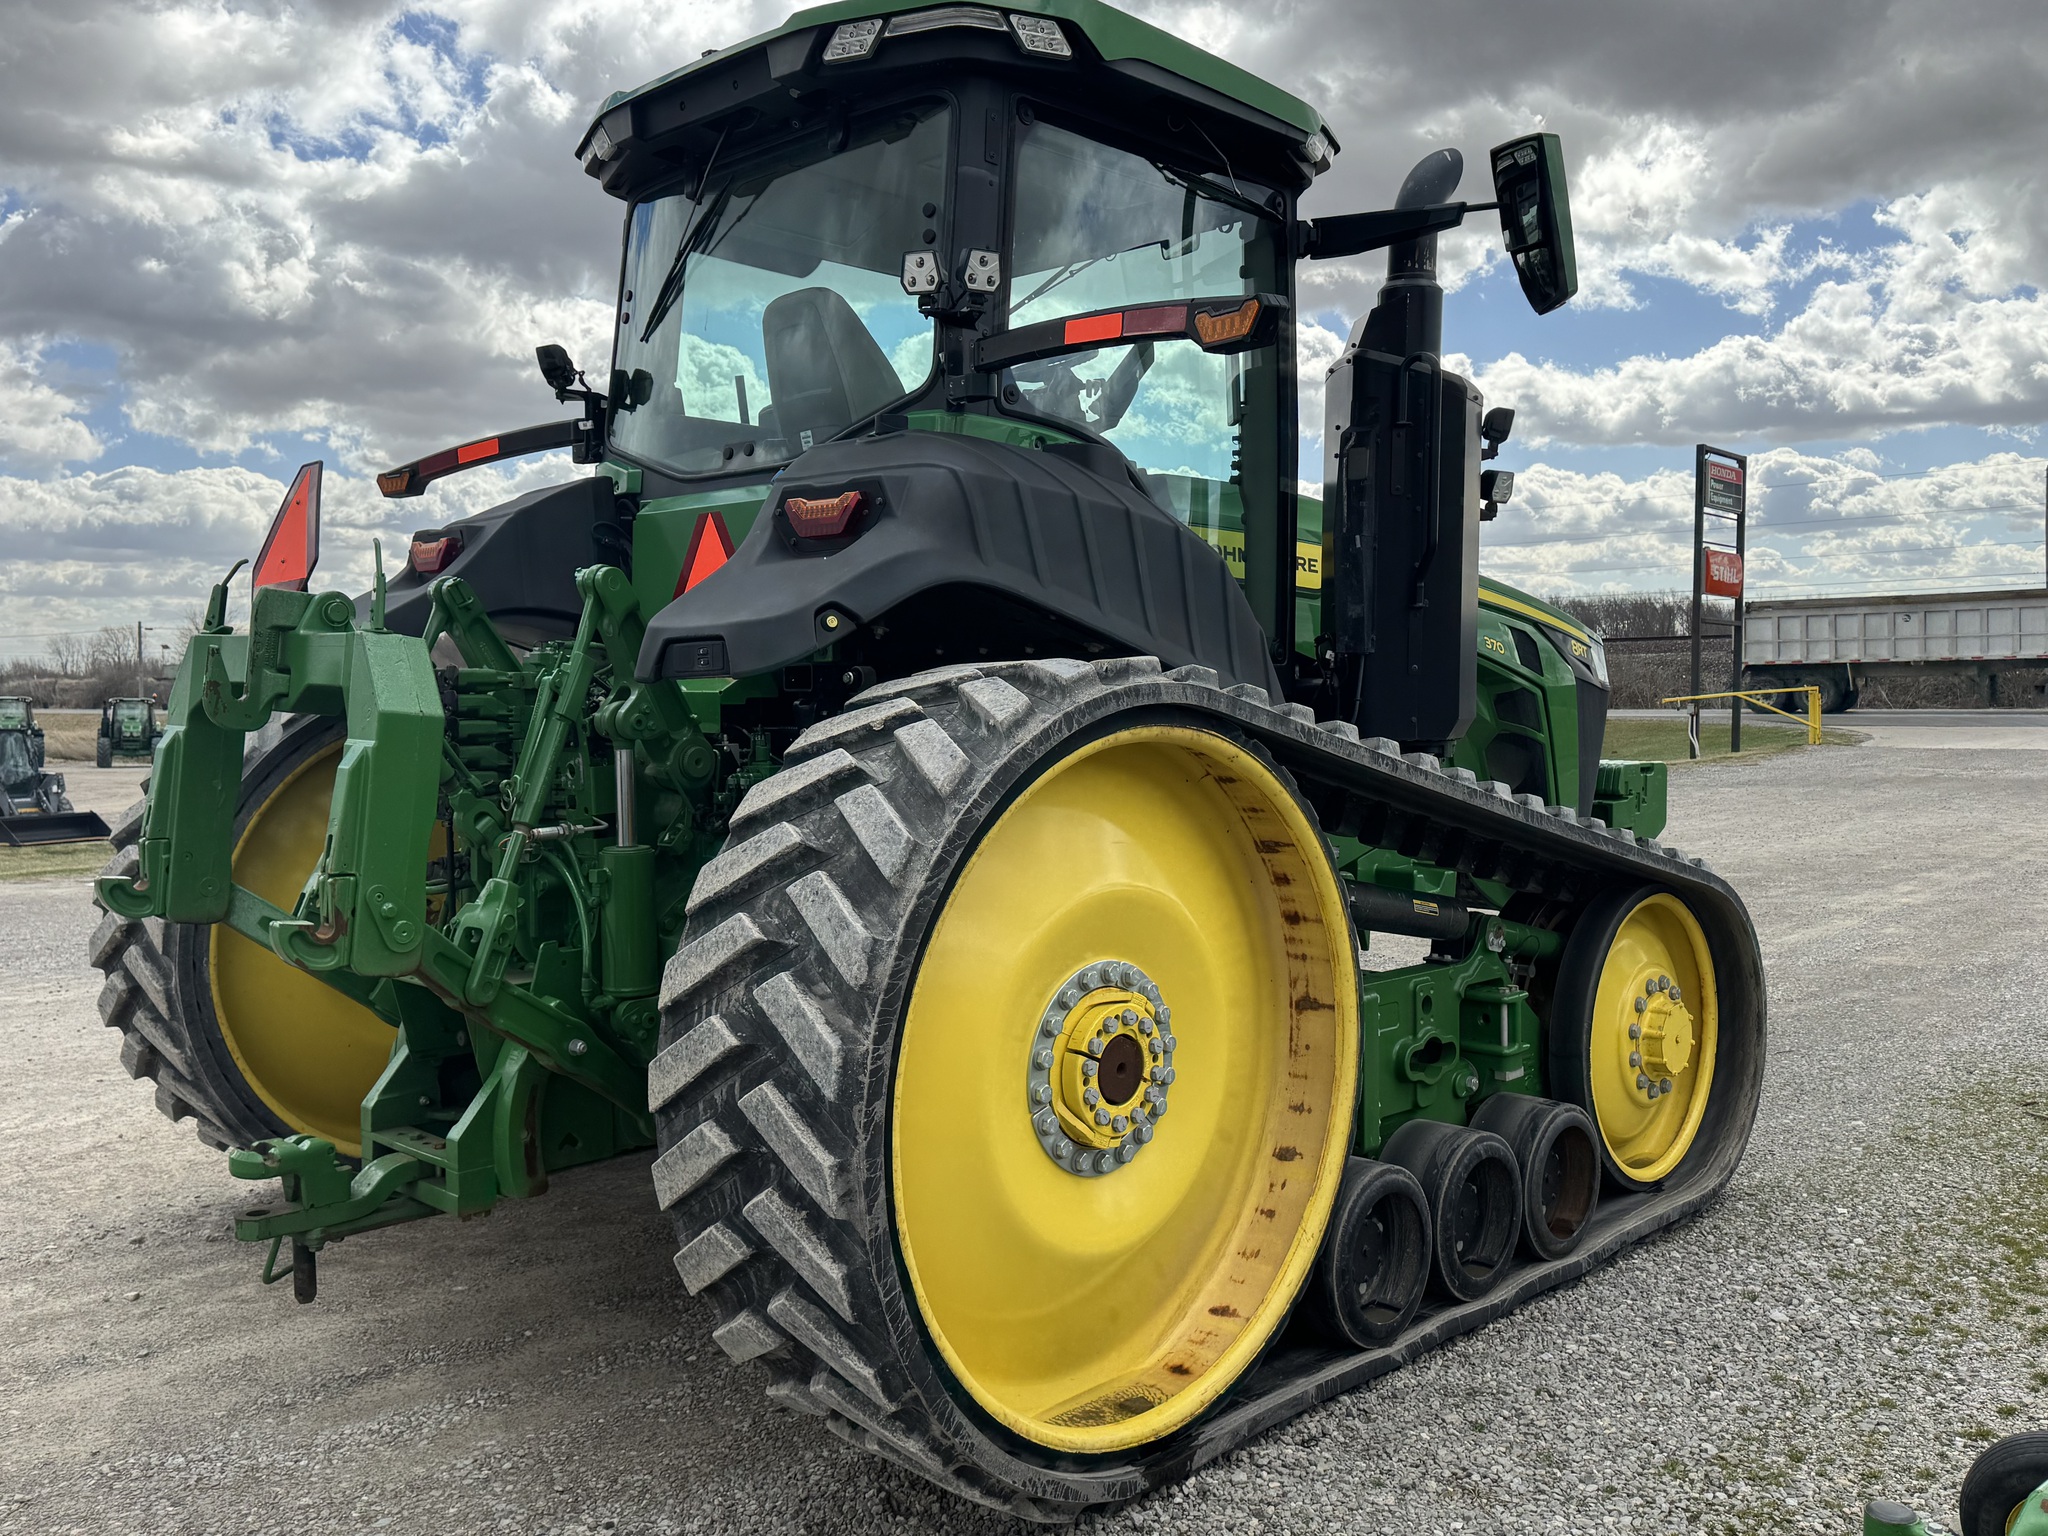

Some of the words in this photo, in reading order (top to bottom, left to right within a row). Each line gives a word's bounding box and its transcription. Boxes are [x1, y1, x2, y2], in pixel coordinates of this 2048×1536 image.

[1711, 465, 1736, 481] HONDA
[1711, 478, 1724, 491] Power
[1711, 491, 1733, 506] Equipment
[1711, 563, 1740, 584] STIHL
[1483, 636, 1505, 655] 370
[1571, 639, 1588, 658] 8RT
